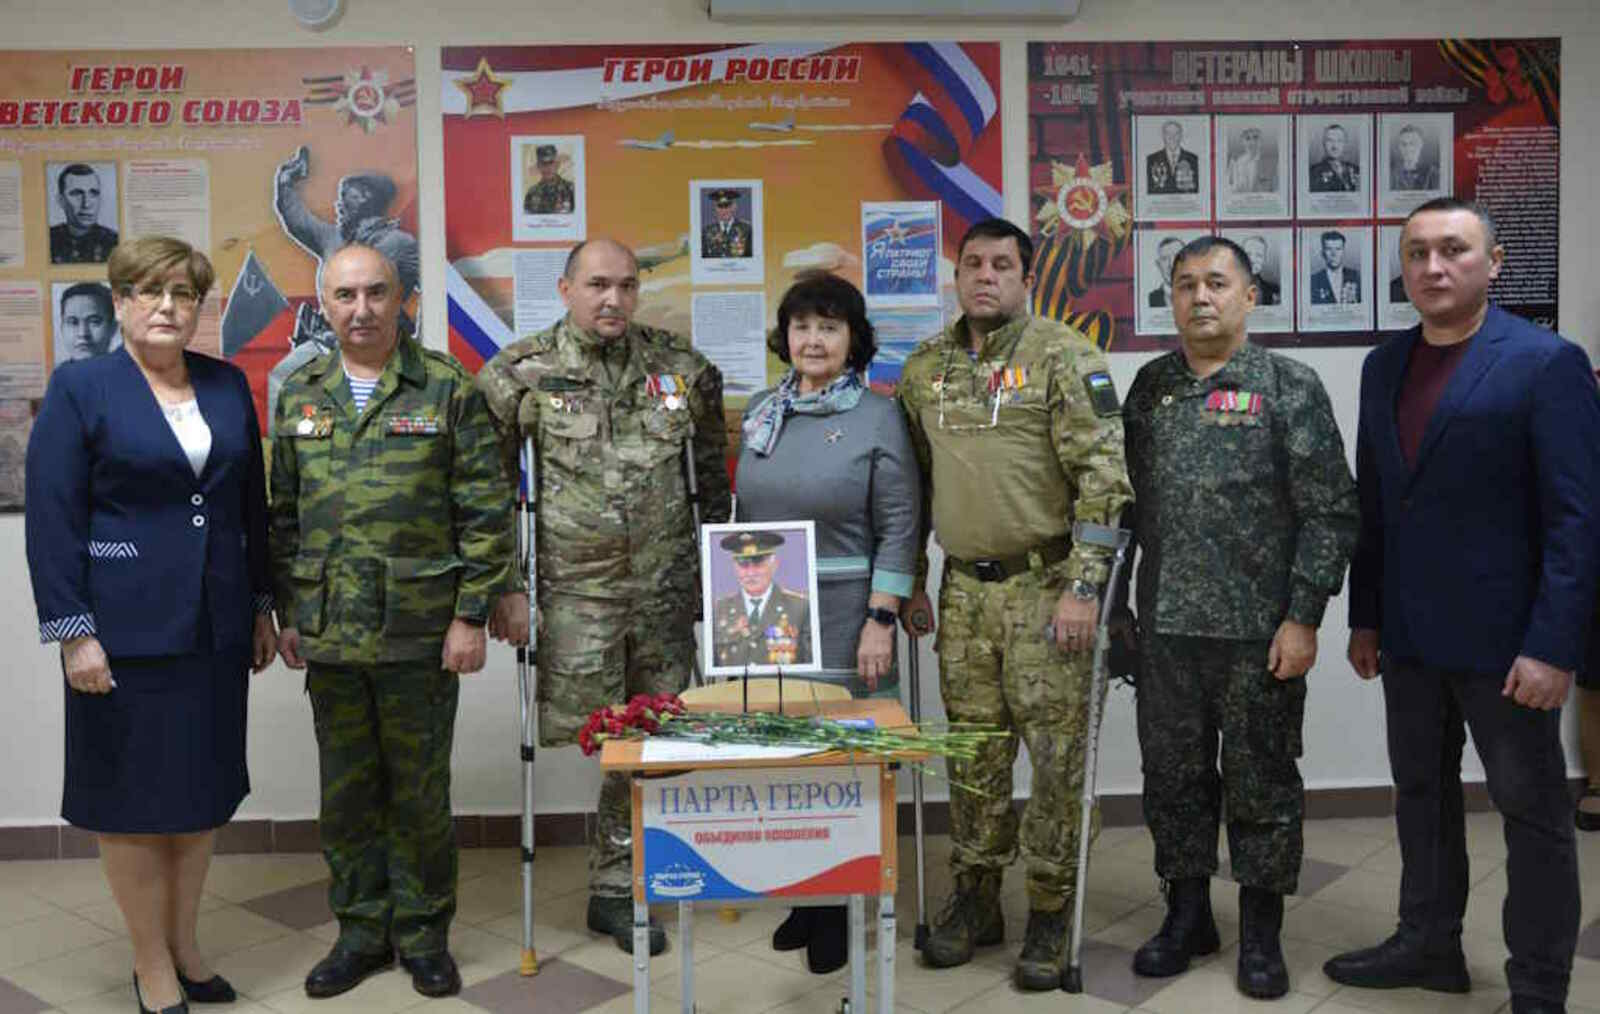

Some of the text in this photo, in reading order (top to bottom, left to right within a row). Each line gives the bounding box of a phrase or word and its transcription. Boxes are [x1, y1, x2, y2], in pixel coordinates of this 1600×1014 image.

[70, 65, 185, 92] ГЕРОИ
[602, 57, 861, 83] ГЕРОИ РОССИИ
[1172, 49, 1412, 84] ВЕТЕРАНЫ ШКОЛЫ
[0, 99, 302, 126] ВЕТСКОГО СОЮЗА
[660, 781, 864, 814] ПАРТА ГЕРОЯ
